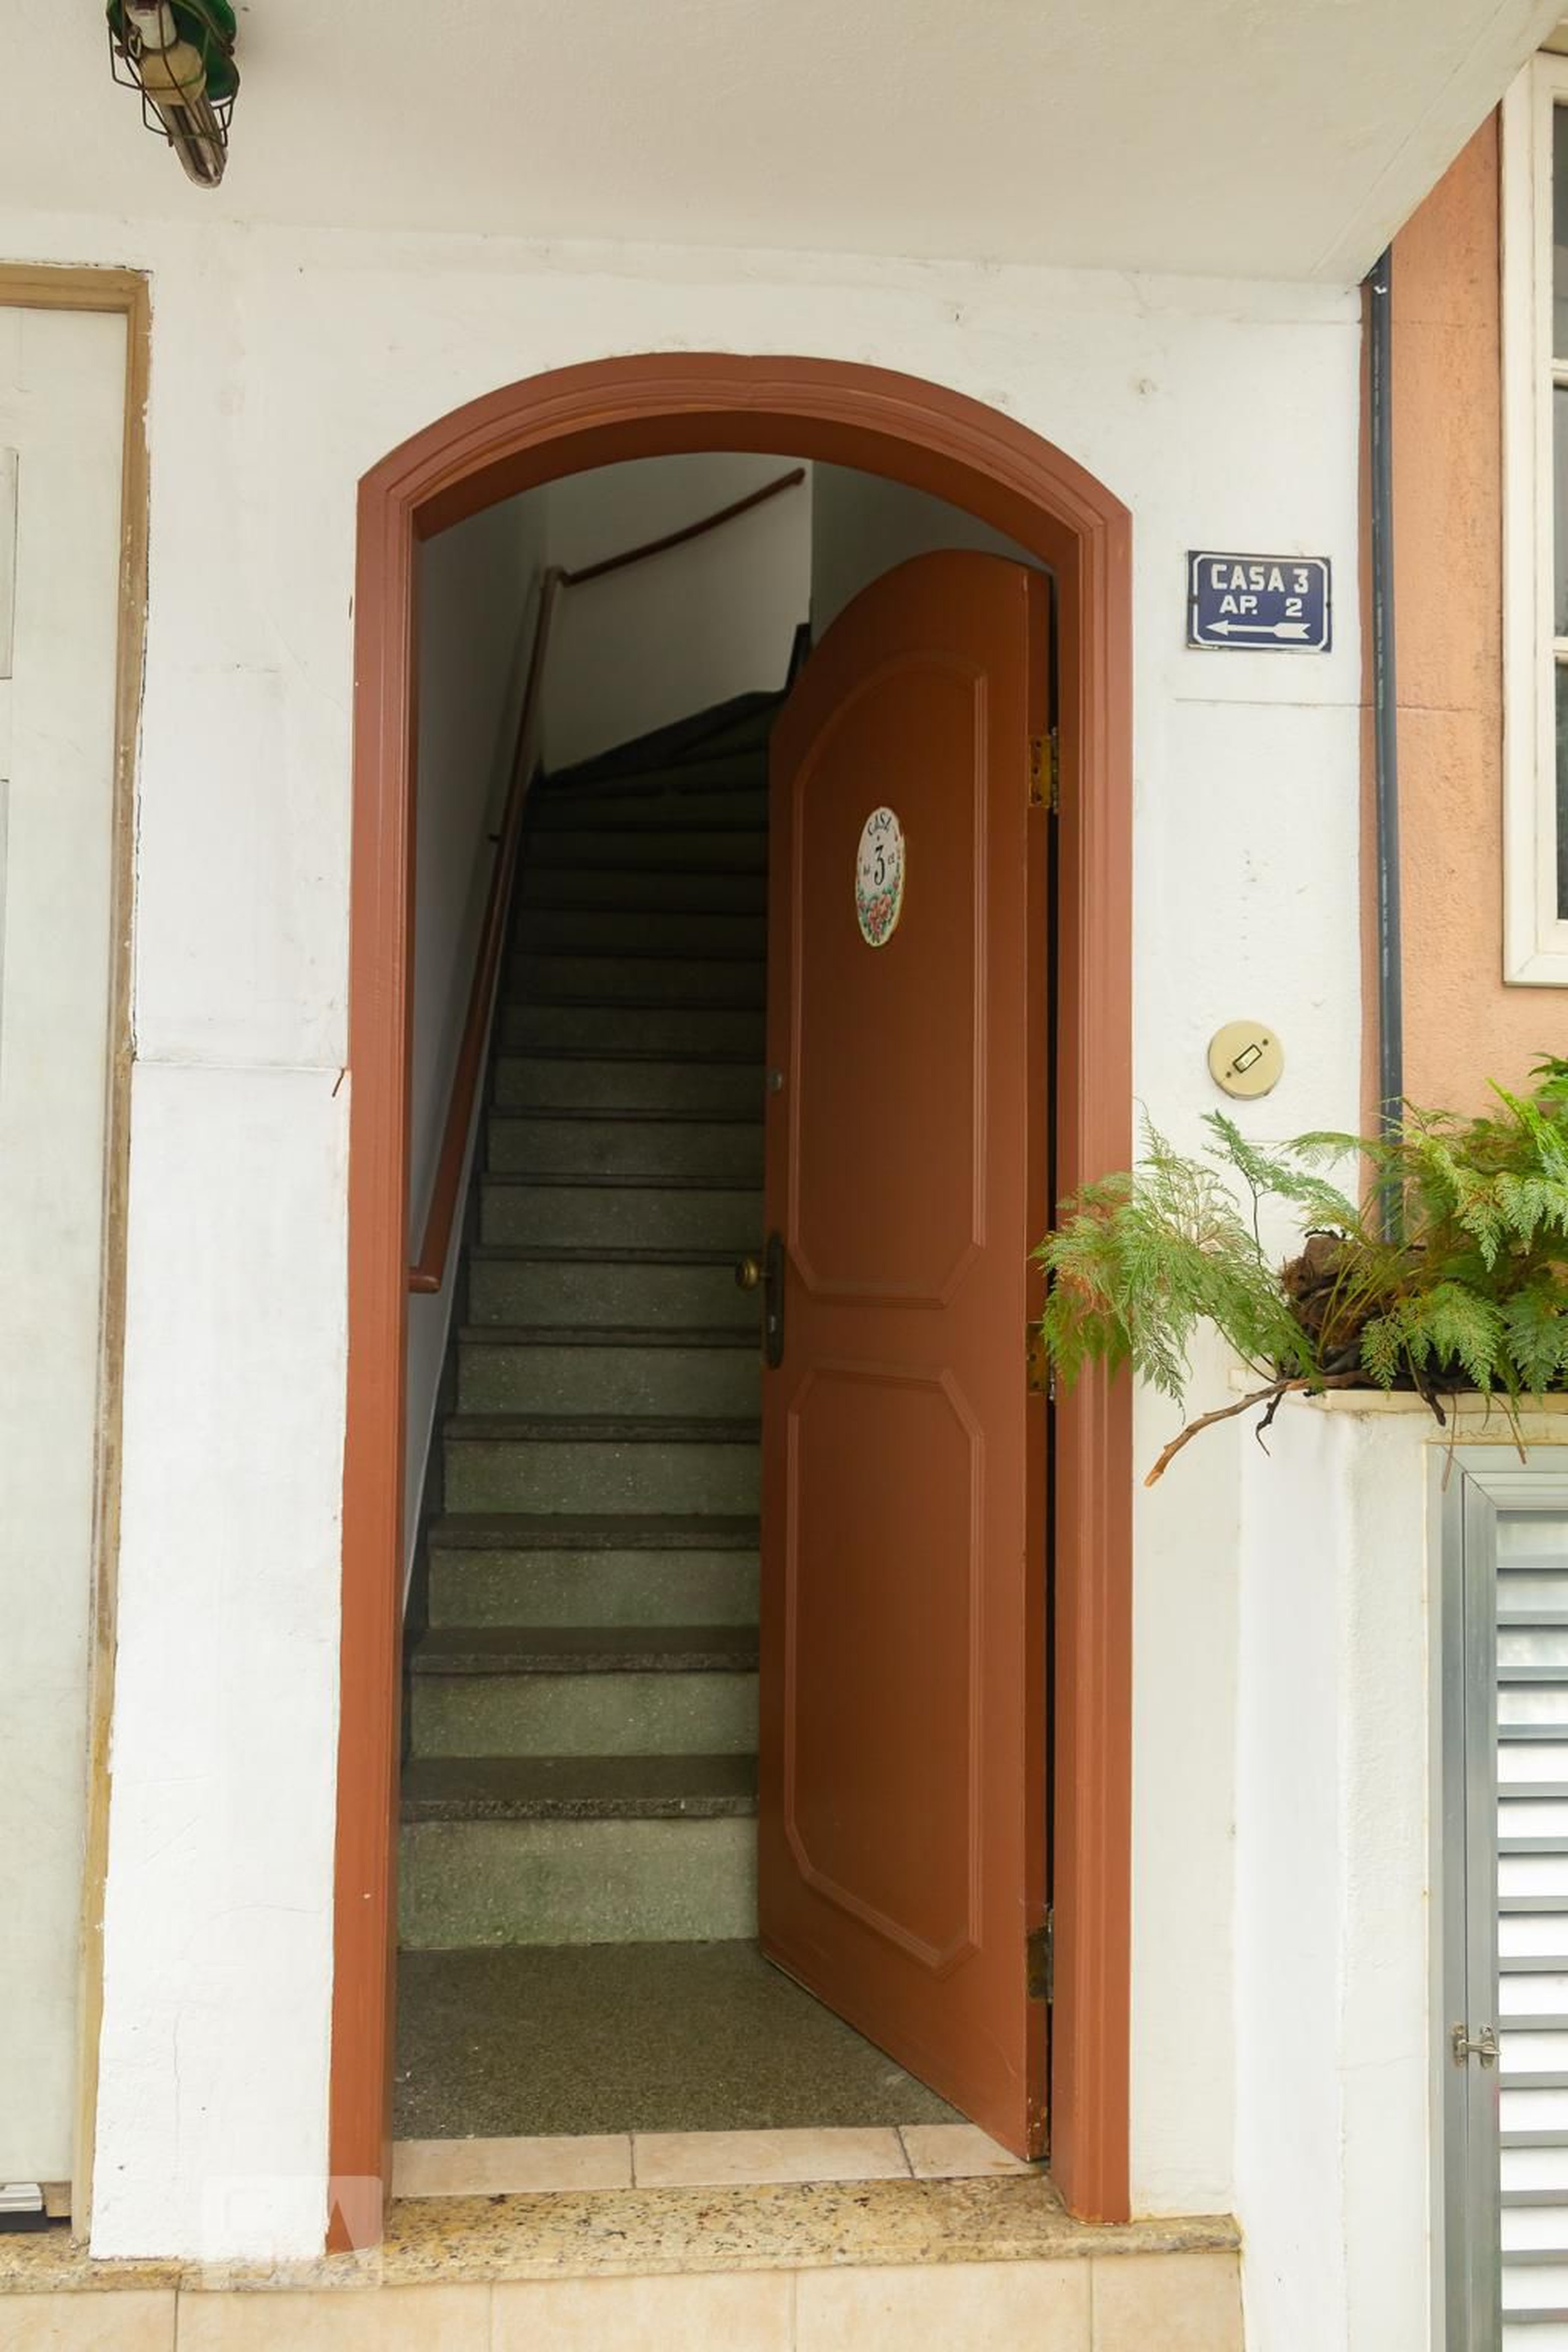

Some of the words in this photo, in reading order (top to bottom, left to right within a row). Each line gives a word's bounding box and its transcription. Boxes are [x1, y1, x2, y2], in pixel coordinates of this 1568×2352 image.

[1211, 564, 1285, 592] CASA
[1293, 568, 1309, 593] 3
[1219, 595, 1258, 615] AP.
[1285, 597, 1302, 617] 2
[874, 844, 885, 885] 3
